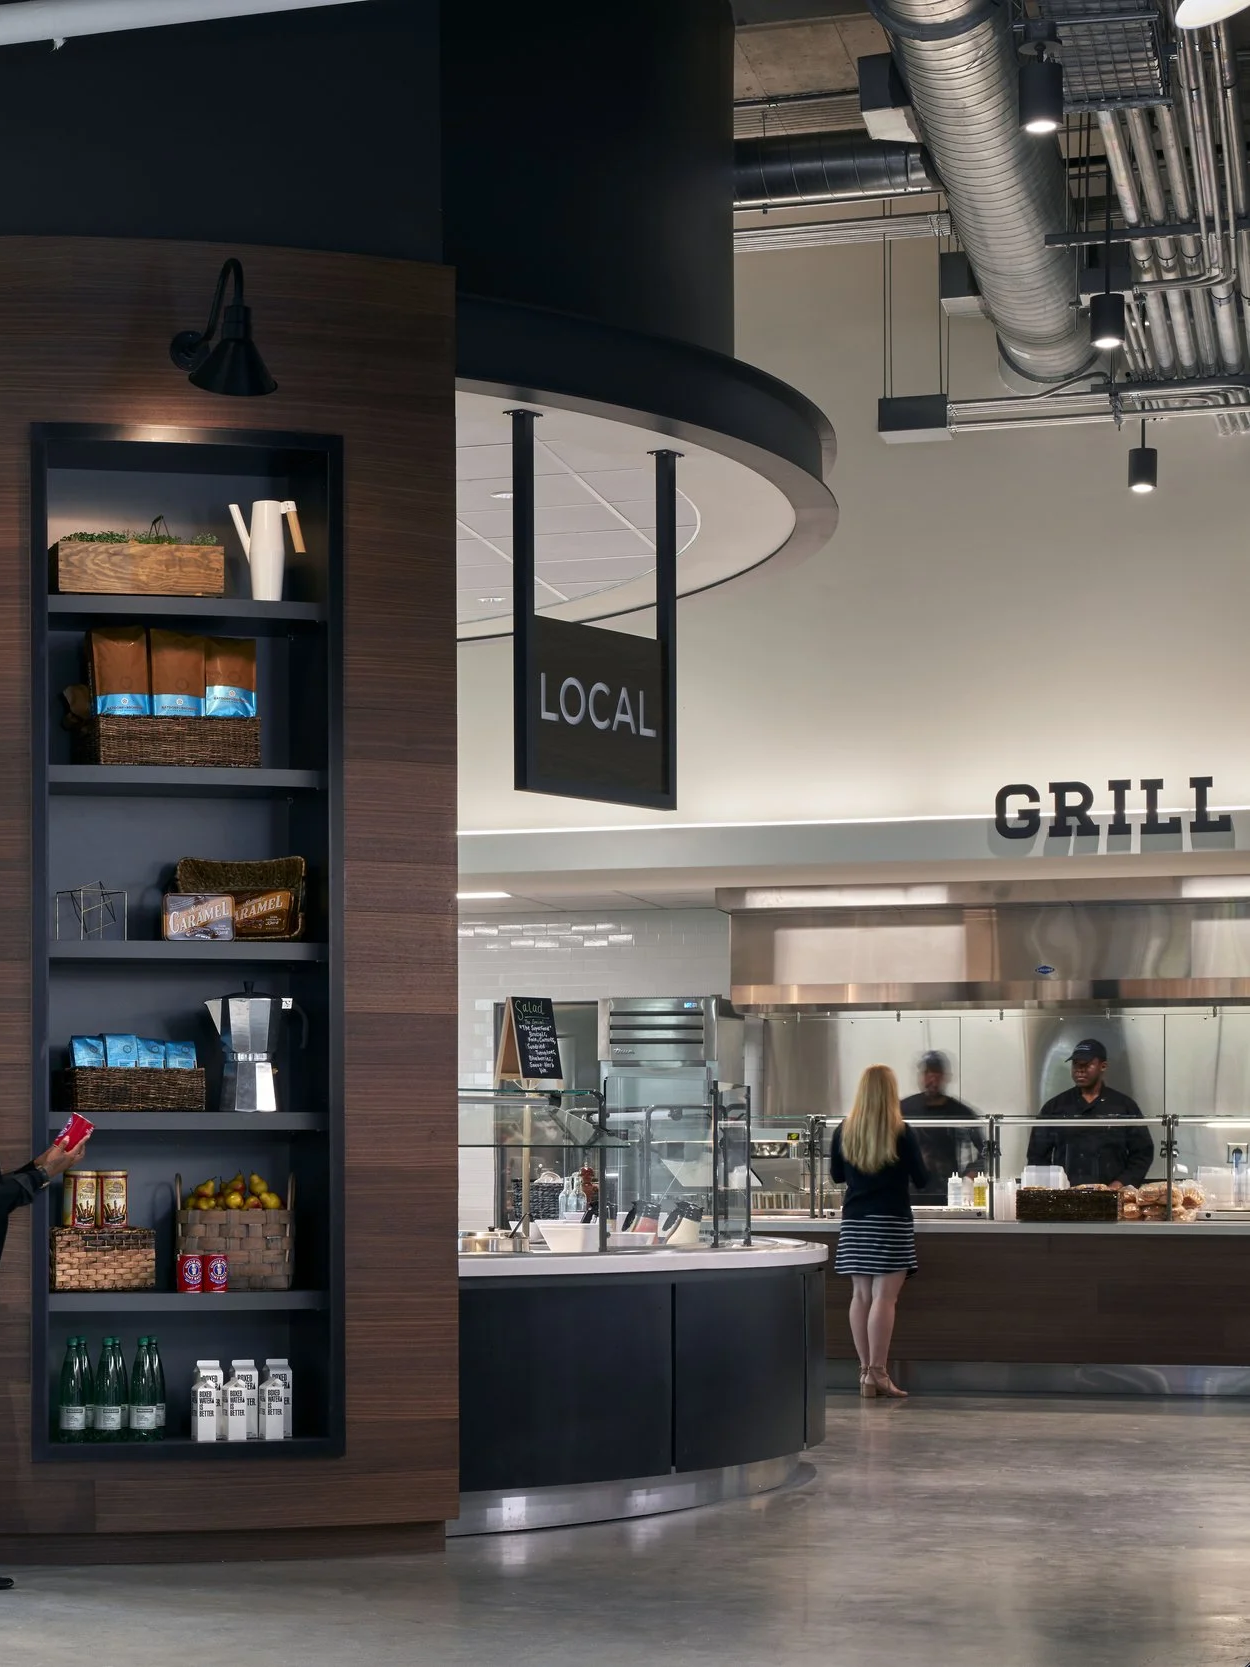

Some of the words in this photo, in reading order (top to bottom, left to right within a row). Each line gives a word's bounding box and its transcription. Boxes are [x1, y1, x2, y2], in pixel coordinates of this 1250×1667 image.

[540, 672, 656, 738] LOCAL
[995, 776, 1232, 839] GRILL
[169, 901, 229, 933] CARAMEL
[234, 895, 283, 921] ARAMEL
[515, 1000, 545, 1020] Salad
